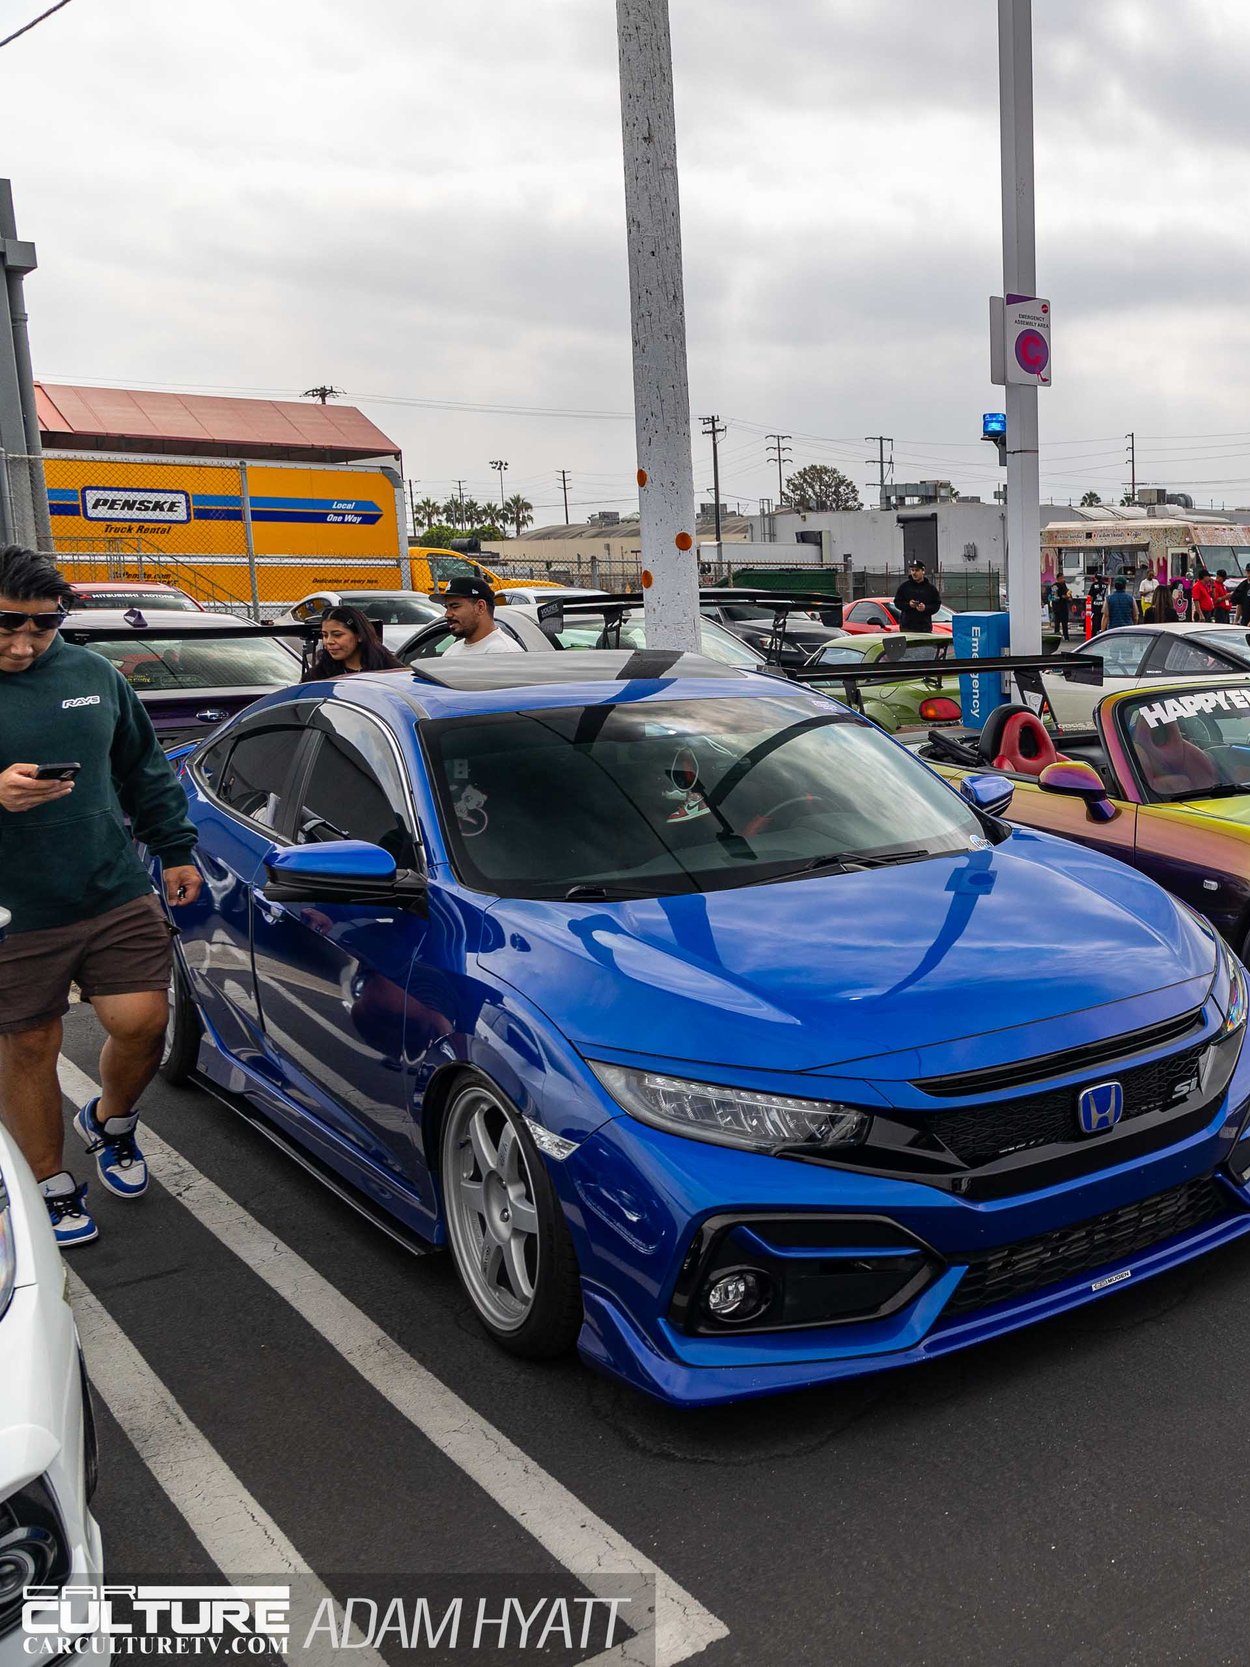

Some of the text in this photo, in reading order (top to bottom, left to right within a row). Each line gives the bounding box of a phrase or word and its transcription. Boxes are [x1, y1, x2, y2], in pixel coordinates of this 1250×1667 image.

[1014, 320, 1037, 328] ASSEMBLY
[1018, 313, 1045, 322] EMERGENCY
[1021, 335, 1042, 366] C
[91, 498, 182, 513] PENSKE
[332, 501, 356, 510] Local
[326, 513, 362, 524] One Way
[104, 524, 172, 535] Truck Rental
[970, 626, 981, 719] Emegency
[62, 695, 100, 709] RAYS
[1139, 690, 1231, 729] HAPPY
[1172, 1076, 1199, 1099] Si
[1107, 1271, 1129, 1284] MUGEN
